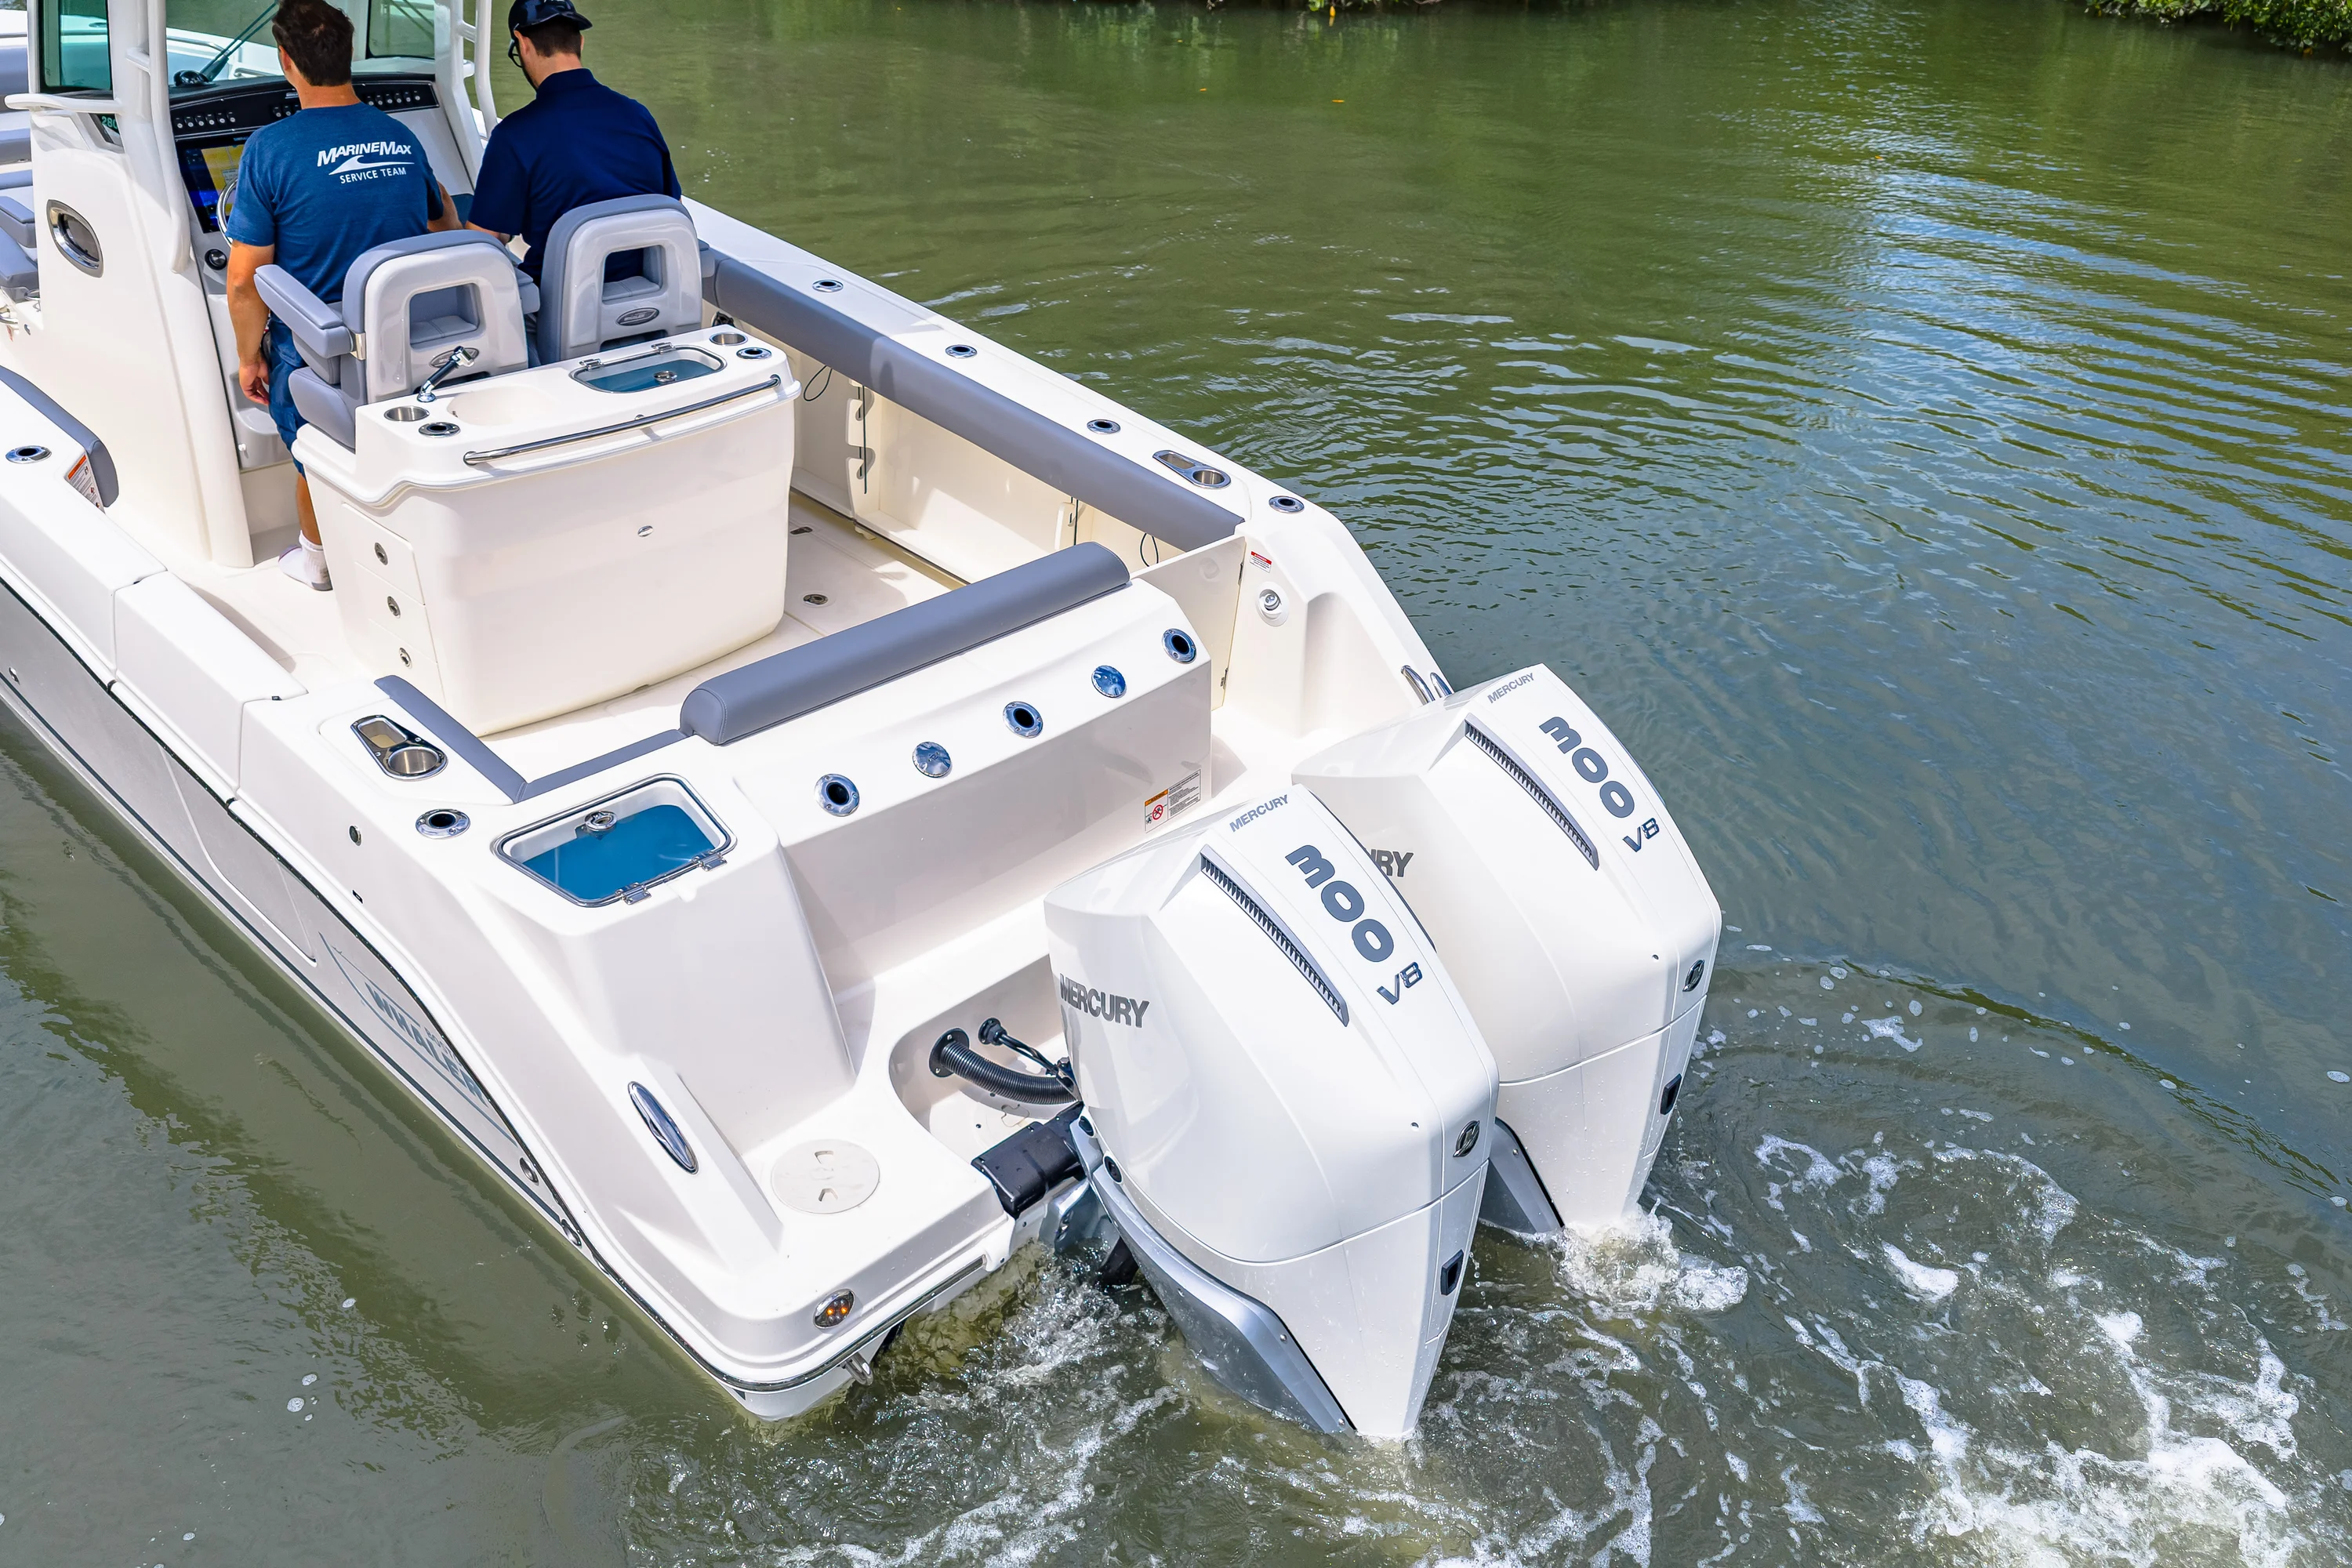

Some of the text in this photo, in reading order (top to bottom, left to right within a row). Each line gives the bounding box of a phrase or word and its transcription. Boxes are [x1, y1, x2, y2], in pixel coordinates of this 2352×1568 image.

[339, 167, 407, 184] SERVICE TEAM
[1487, 672, 1534, 704] MERCURY
[1539, 716, 1660, 852] 300 V8
[1229, 794, 1289, 833] MERCURY
[1284, 844, 1423, 1005] 300 V8
[1059, 973, 1150, 1028] MERCURY
[365, 982, 489, 1108] WHALER
